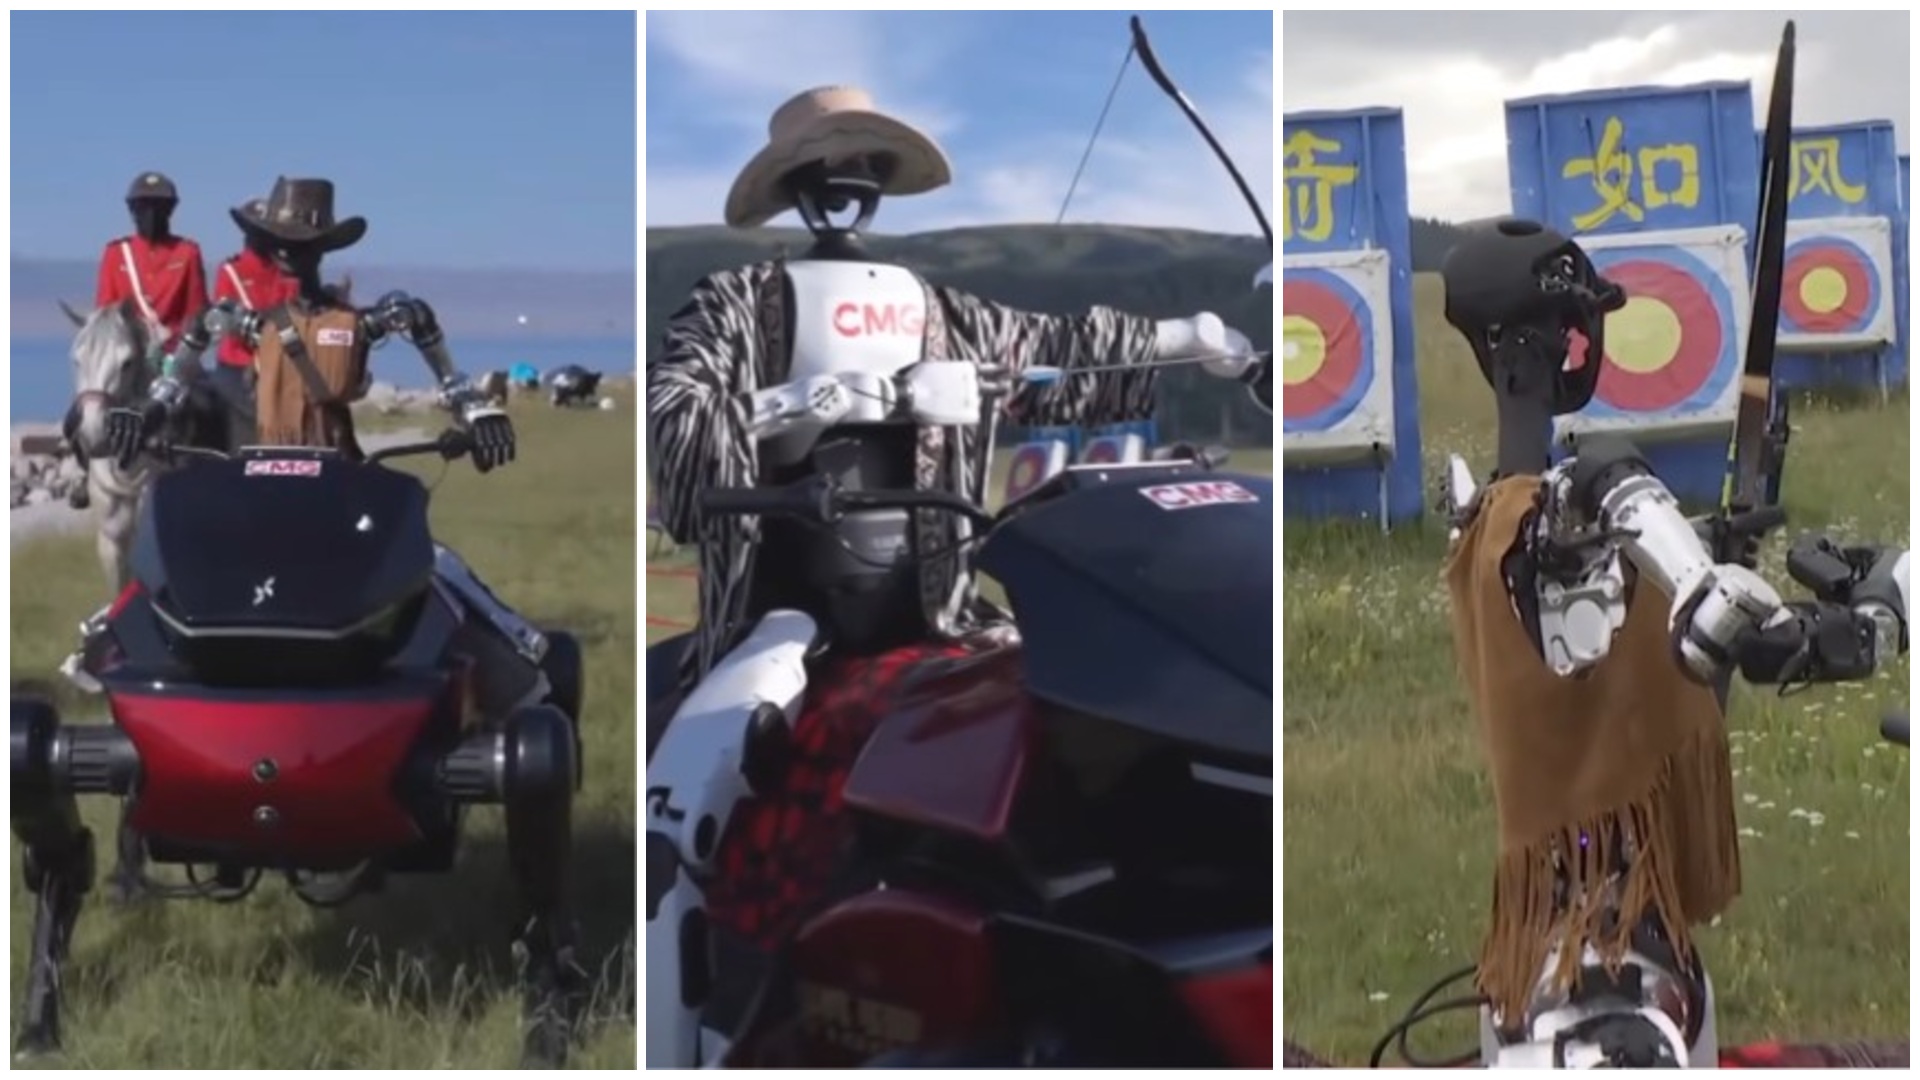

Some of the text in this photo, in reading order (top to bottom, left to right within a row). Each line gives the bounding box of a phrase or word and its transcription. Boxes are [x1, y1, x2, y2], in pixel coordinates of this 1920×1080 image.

[1561, 115, 1699, 231] 如
[1787, 136, 1867, 203] 风
[833, 303, 926, 337] CMG
[247, 461, 319, 475] CMG
[1149, 482, 1252, 506] CMG
